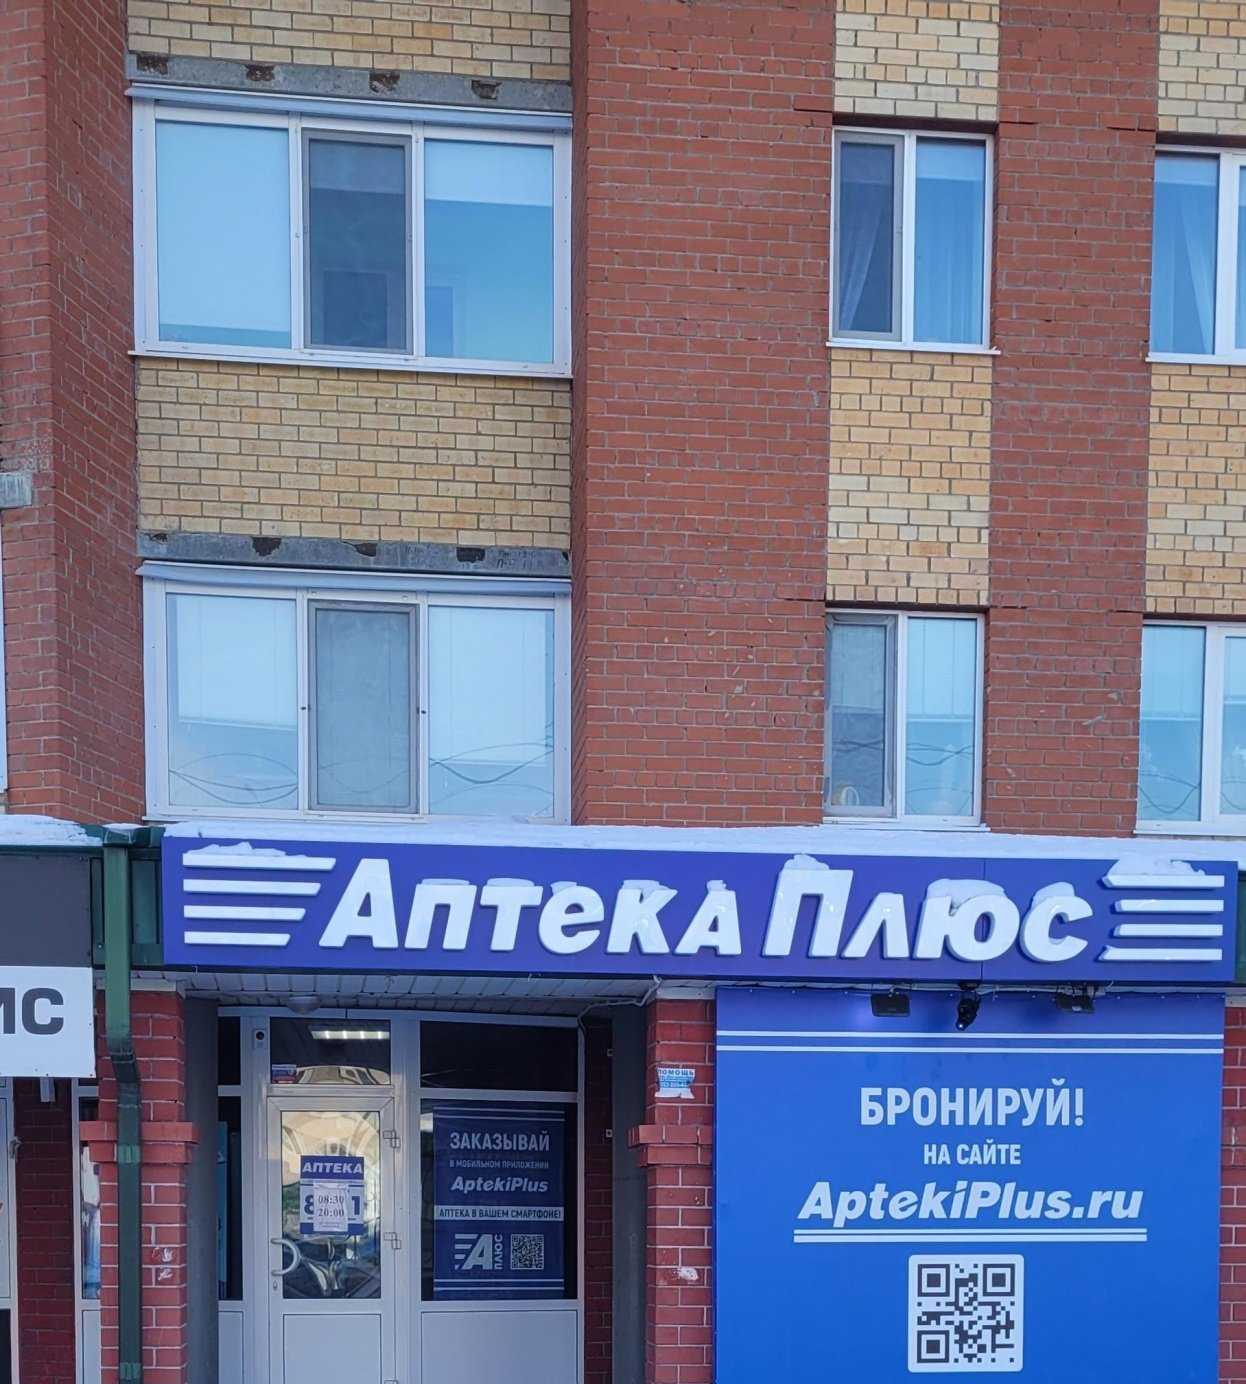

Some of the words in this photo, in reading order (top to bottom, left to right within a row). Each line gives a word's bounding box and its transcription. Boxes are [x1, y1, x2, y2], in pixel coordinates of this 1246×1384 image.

[859, 1077, 1085, 1127] БРОНИРУЙ!
[449, 1130, 550, 1151] ЗАКАЗЫВАЙ
[923, 1144, 952, 1165] НА
[956, 1139, 1022, 1165] САЙТЕ
[302, 1162, 363, 1174] АПТЕКА
[456, 1160, 500, 1168] МОБИЛЬНОМ
[450, 1176, 549, 1194] AptekiPlus
[439, 1208, 470, 1218] АПТЕКА
[471, 1209, 477, 1218] В
[479, 1209, 509, 1218] ВАШЕМ
[798, 1181, 1144, 1228] AptekiPlus.ru
[494, 1233, 503, 1270] ПЛЮС
